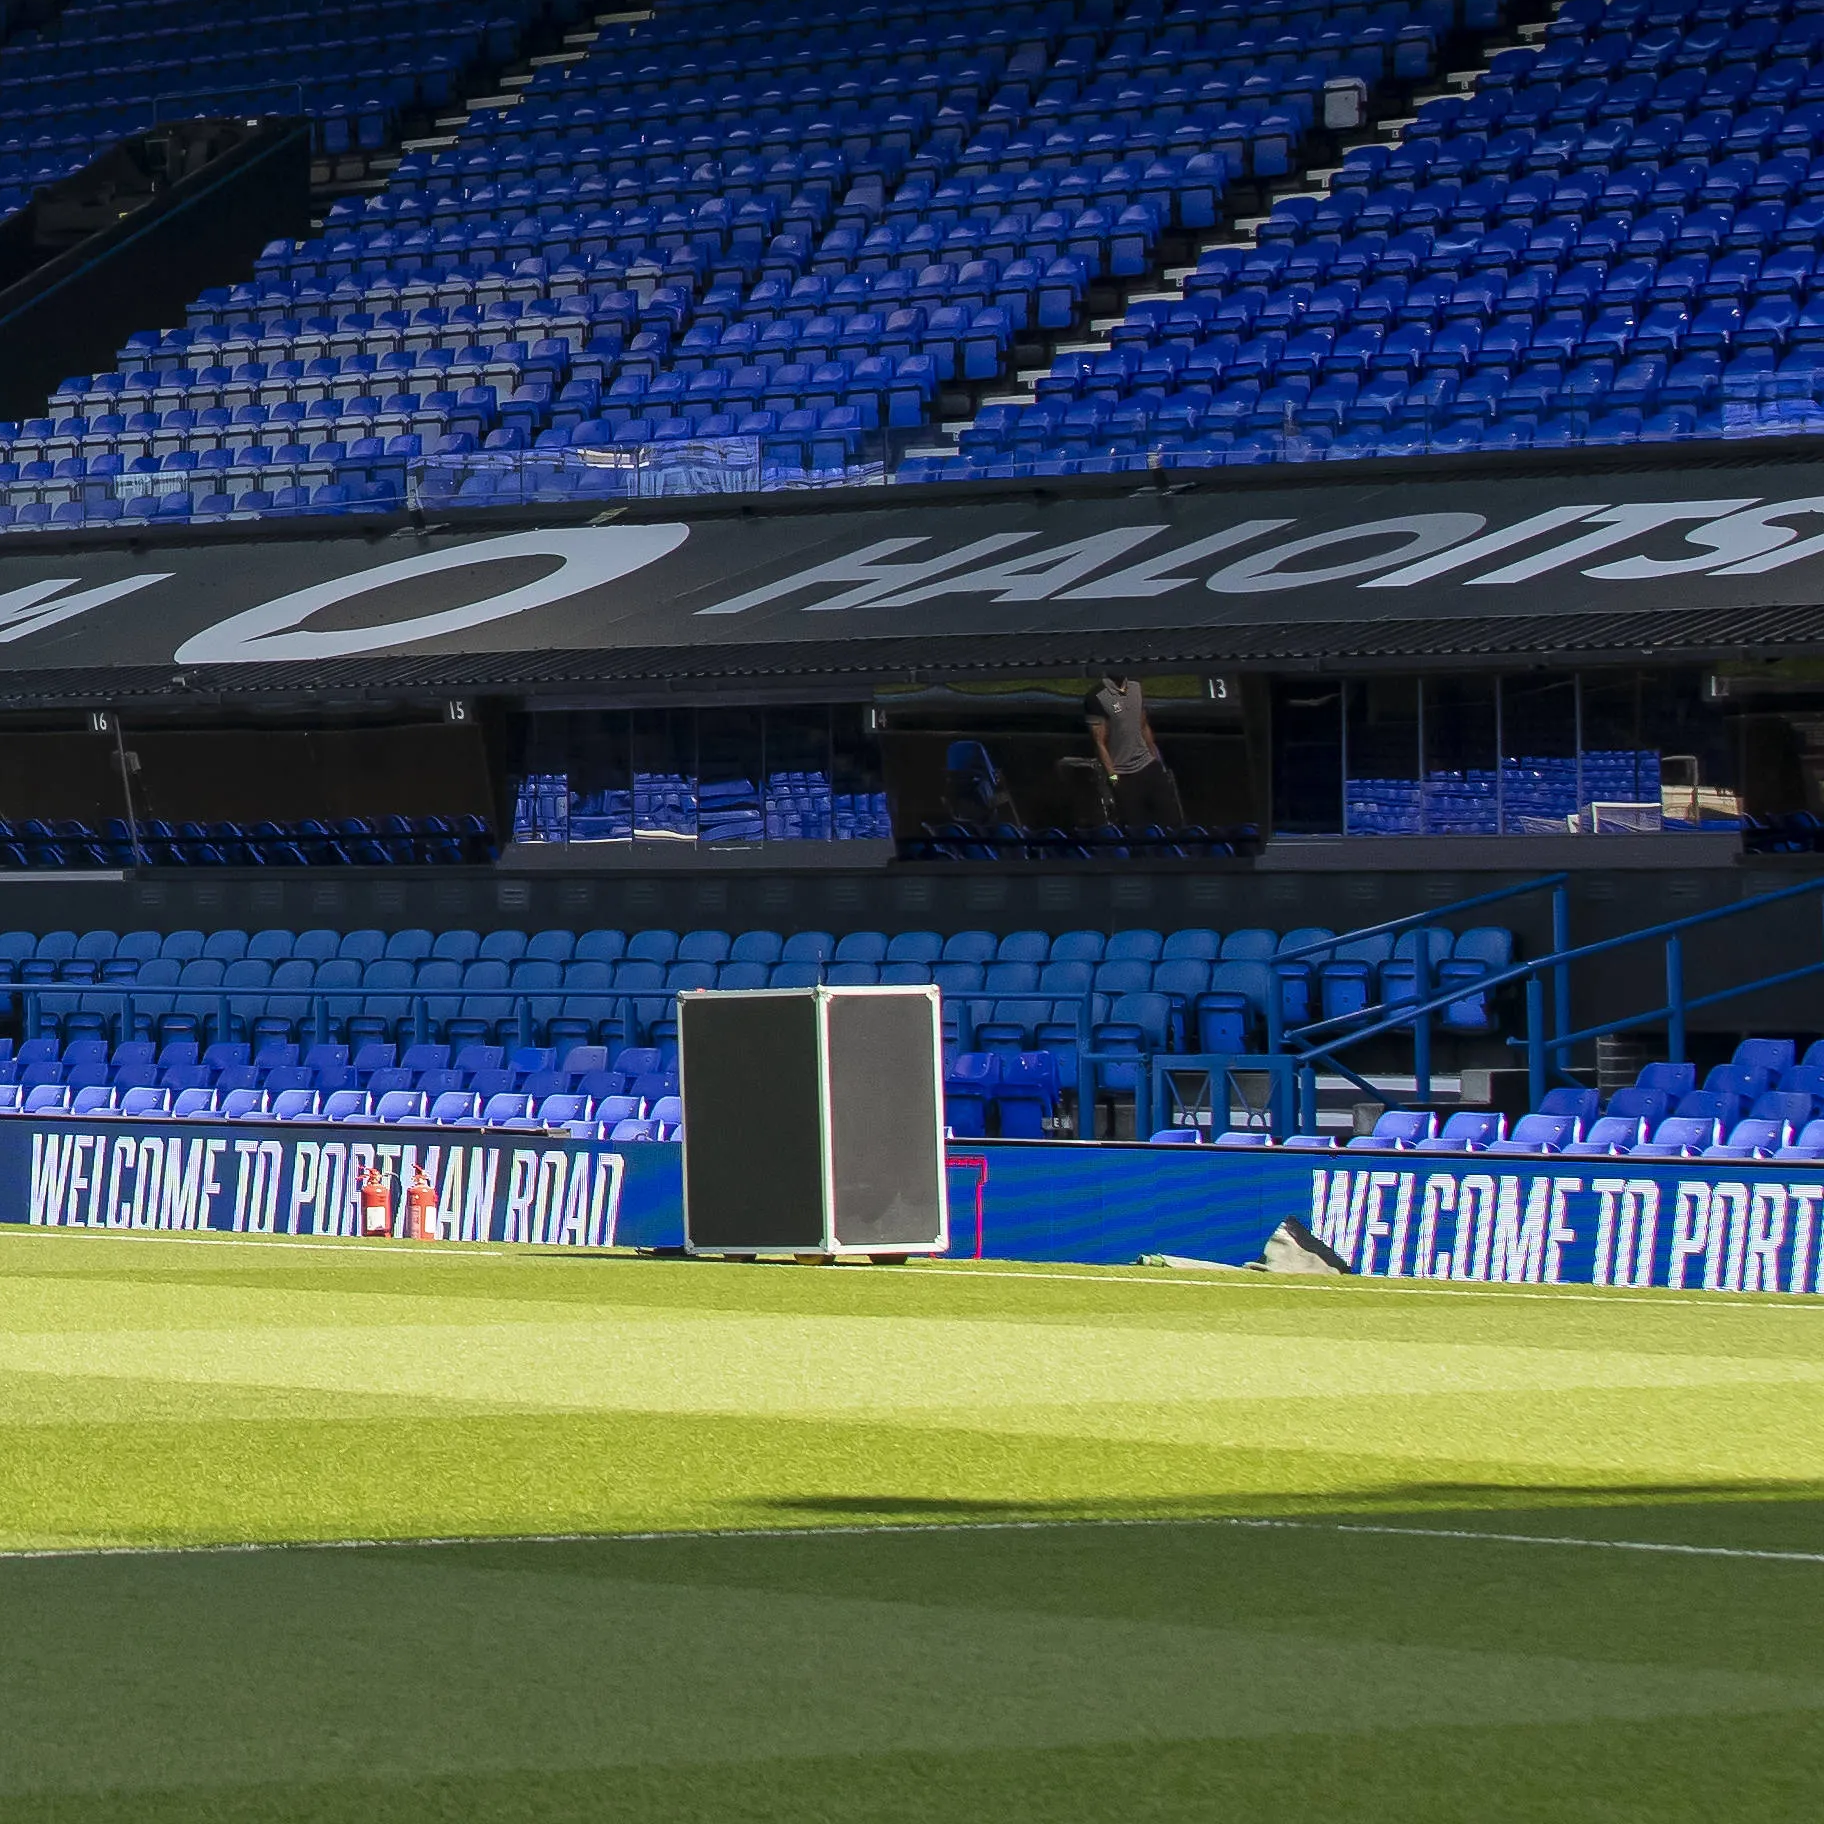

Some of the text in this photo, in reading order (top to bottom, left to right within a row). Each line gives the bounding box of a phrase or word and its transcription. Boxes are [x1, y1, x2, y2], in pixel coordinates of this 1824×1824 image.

[695, 494, 1824, 616] HALOITS
[1209, 678, 1227, 698] 13
[449, 700, 465, 719] 15
[871, 708, 887, 729] 14
[93, 712, 107, 731] 16
[29, 1133, 625, 1247] WELCOME TO PORTMAN ROAD
[1310, 1168, 1824, 1294] WELCOME TO PORT
